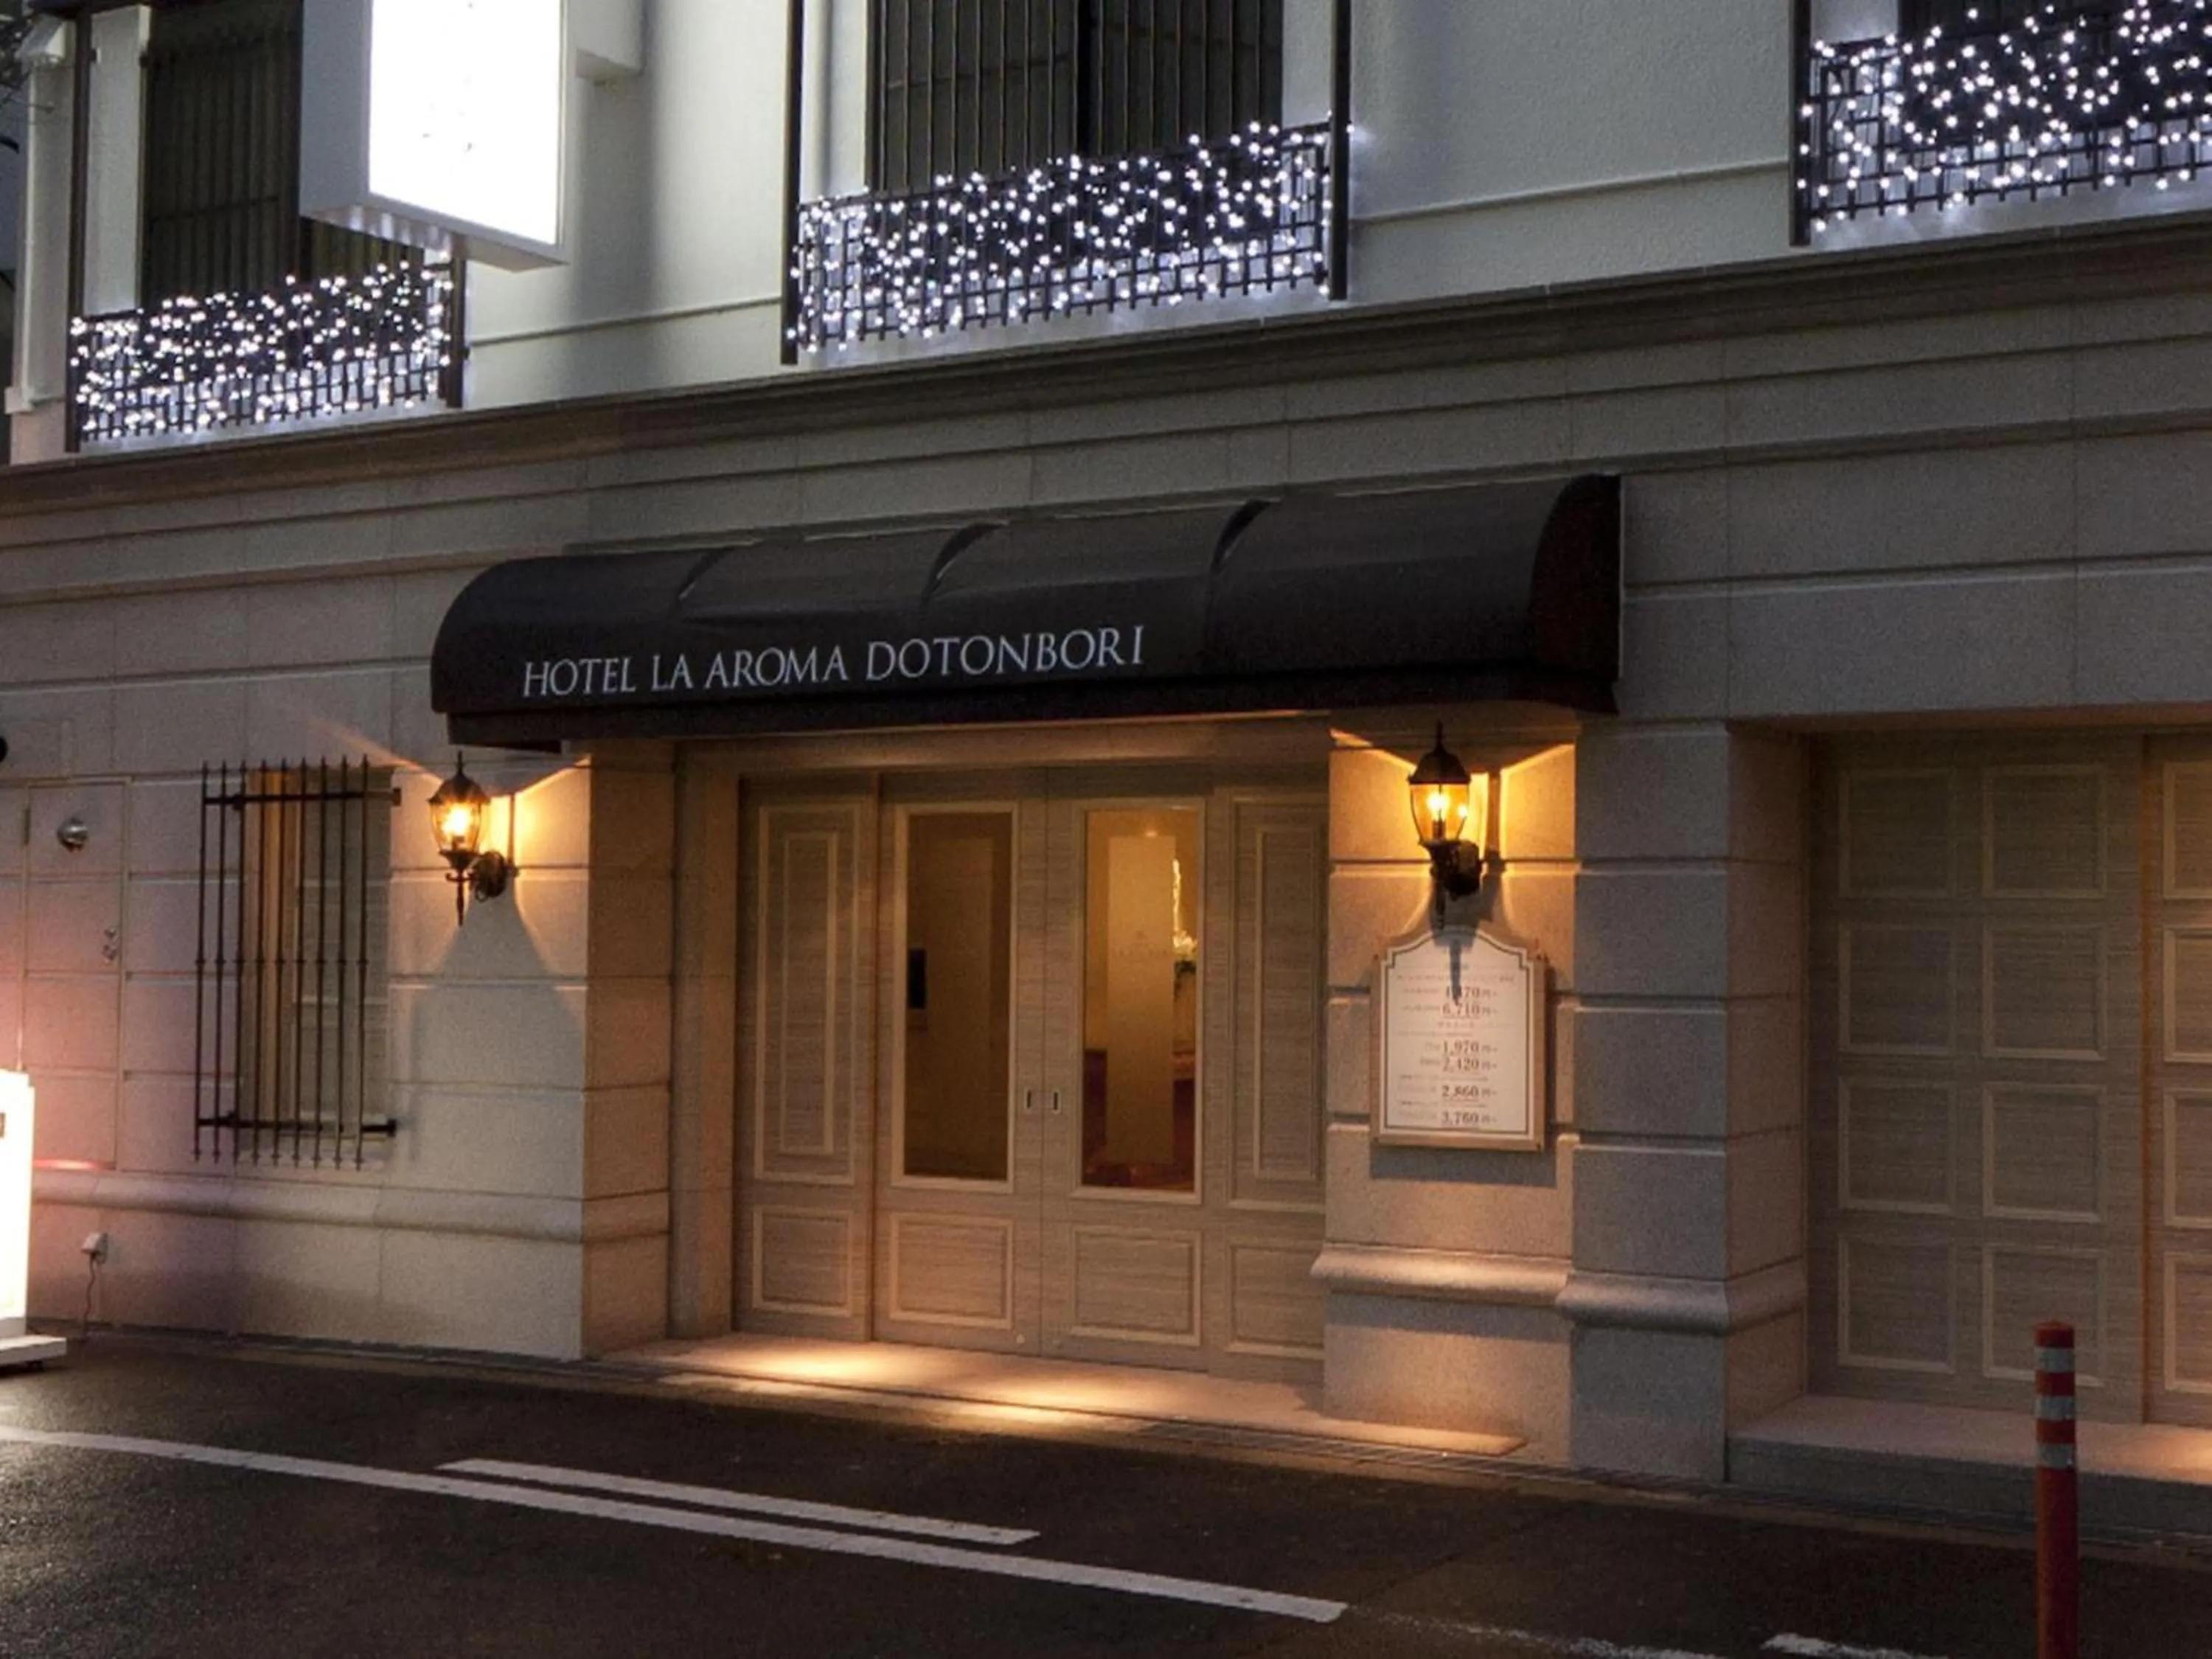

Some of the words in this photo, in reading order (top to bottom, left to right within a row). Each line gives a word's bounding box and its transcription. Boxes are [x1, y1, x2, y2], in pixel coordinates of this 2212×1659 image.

[523, 656, 636, 697] HOTEL
[652, 653, 693, 691] LA
[705, 646, 849, 689] AROMA
[866, 625, 1144, 681] DOTONBORI
